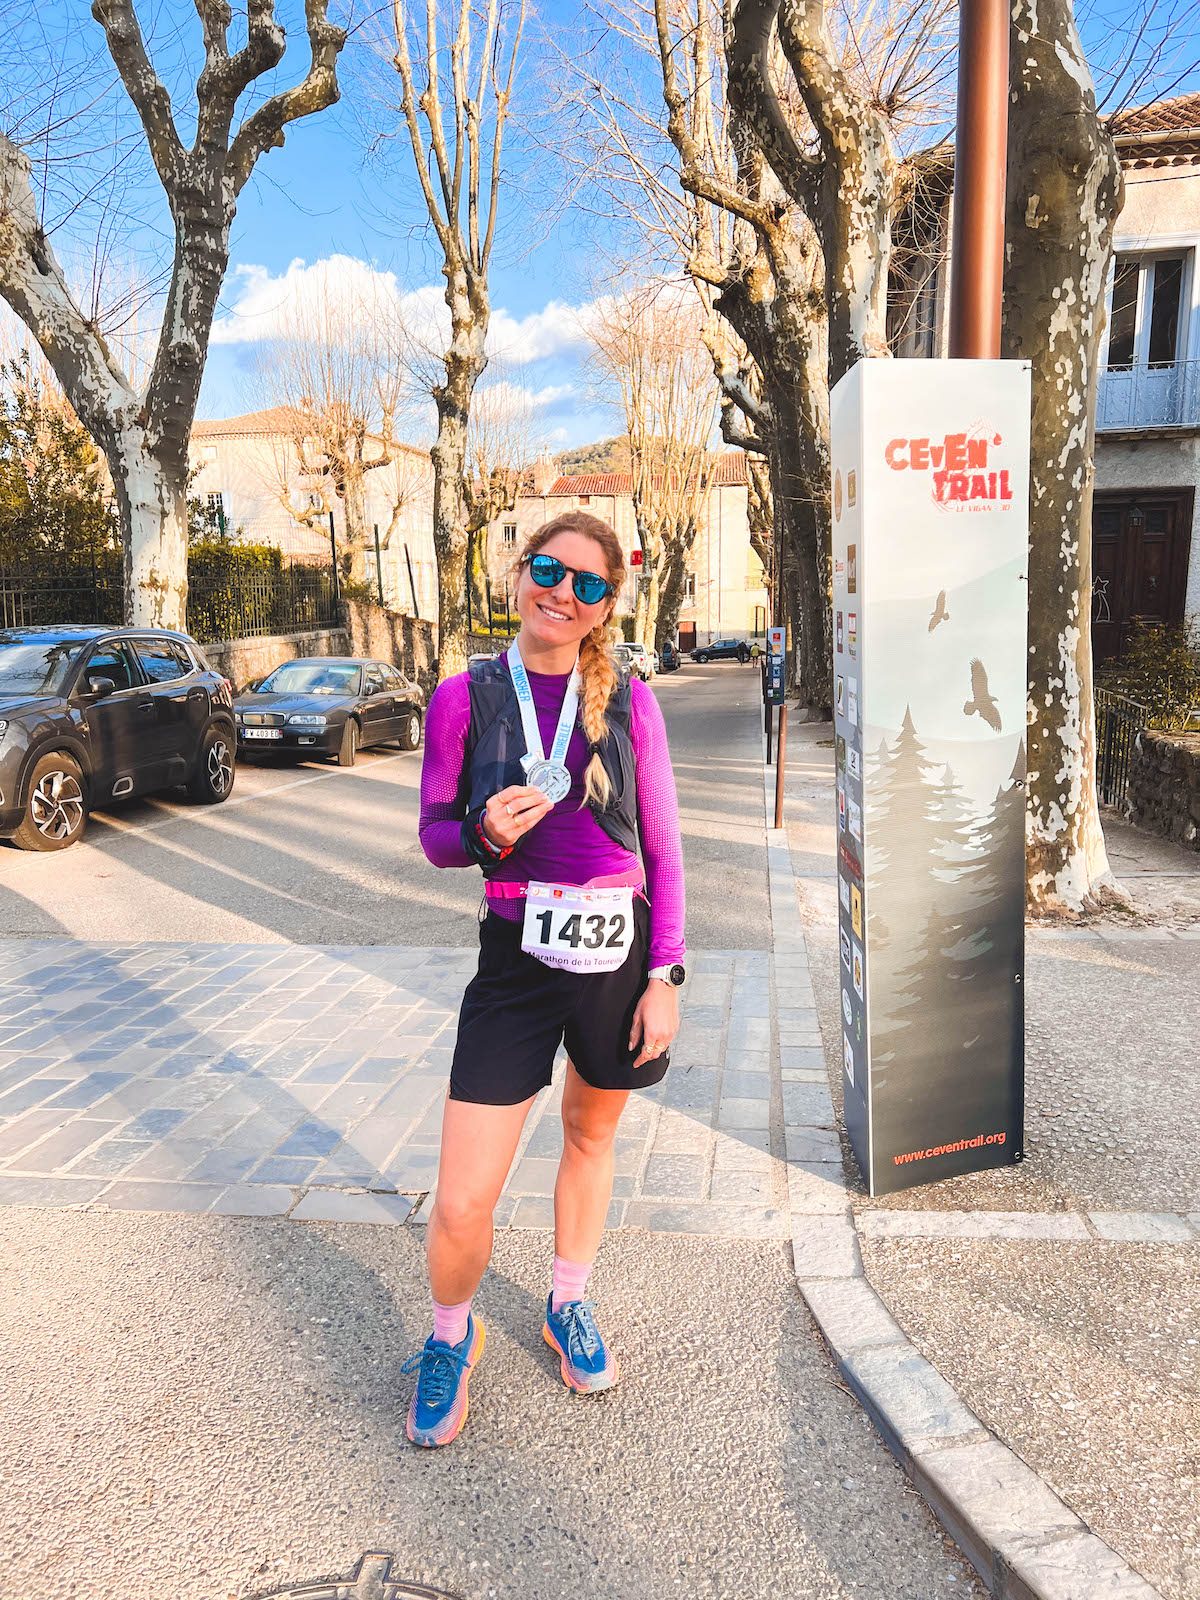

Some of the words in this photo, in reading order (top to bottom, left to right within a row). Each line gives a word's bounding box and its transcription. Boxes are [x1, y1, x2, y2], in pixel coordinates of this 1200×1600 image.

[932, 469, 1013, 502] TRAIL
[511, 664, 531, 702] FINISHER
[256, 730, 269, 738] 403
[553, 722, 571, 759] TOUREILLE
[535, 910, 626, 949] 1432
[528, 951, 569, 965] Marathon
[594, 957, 623, 965] Toure
[894, 1132, 1006, 1165] www.ceventrail.org
